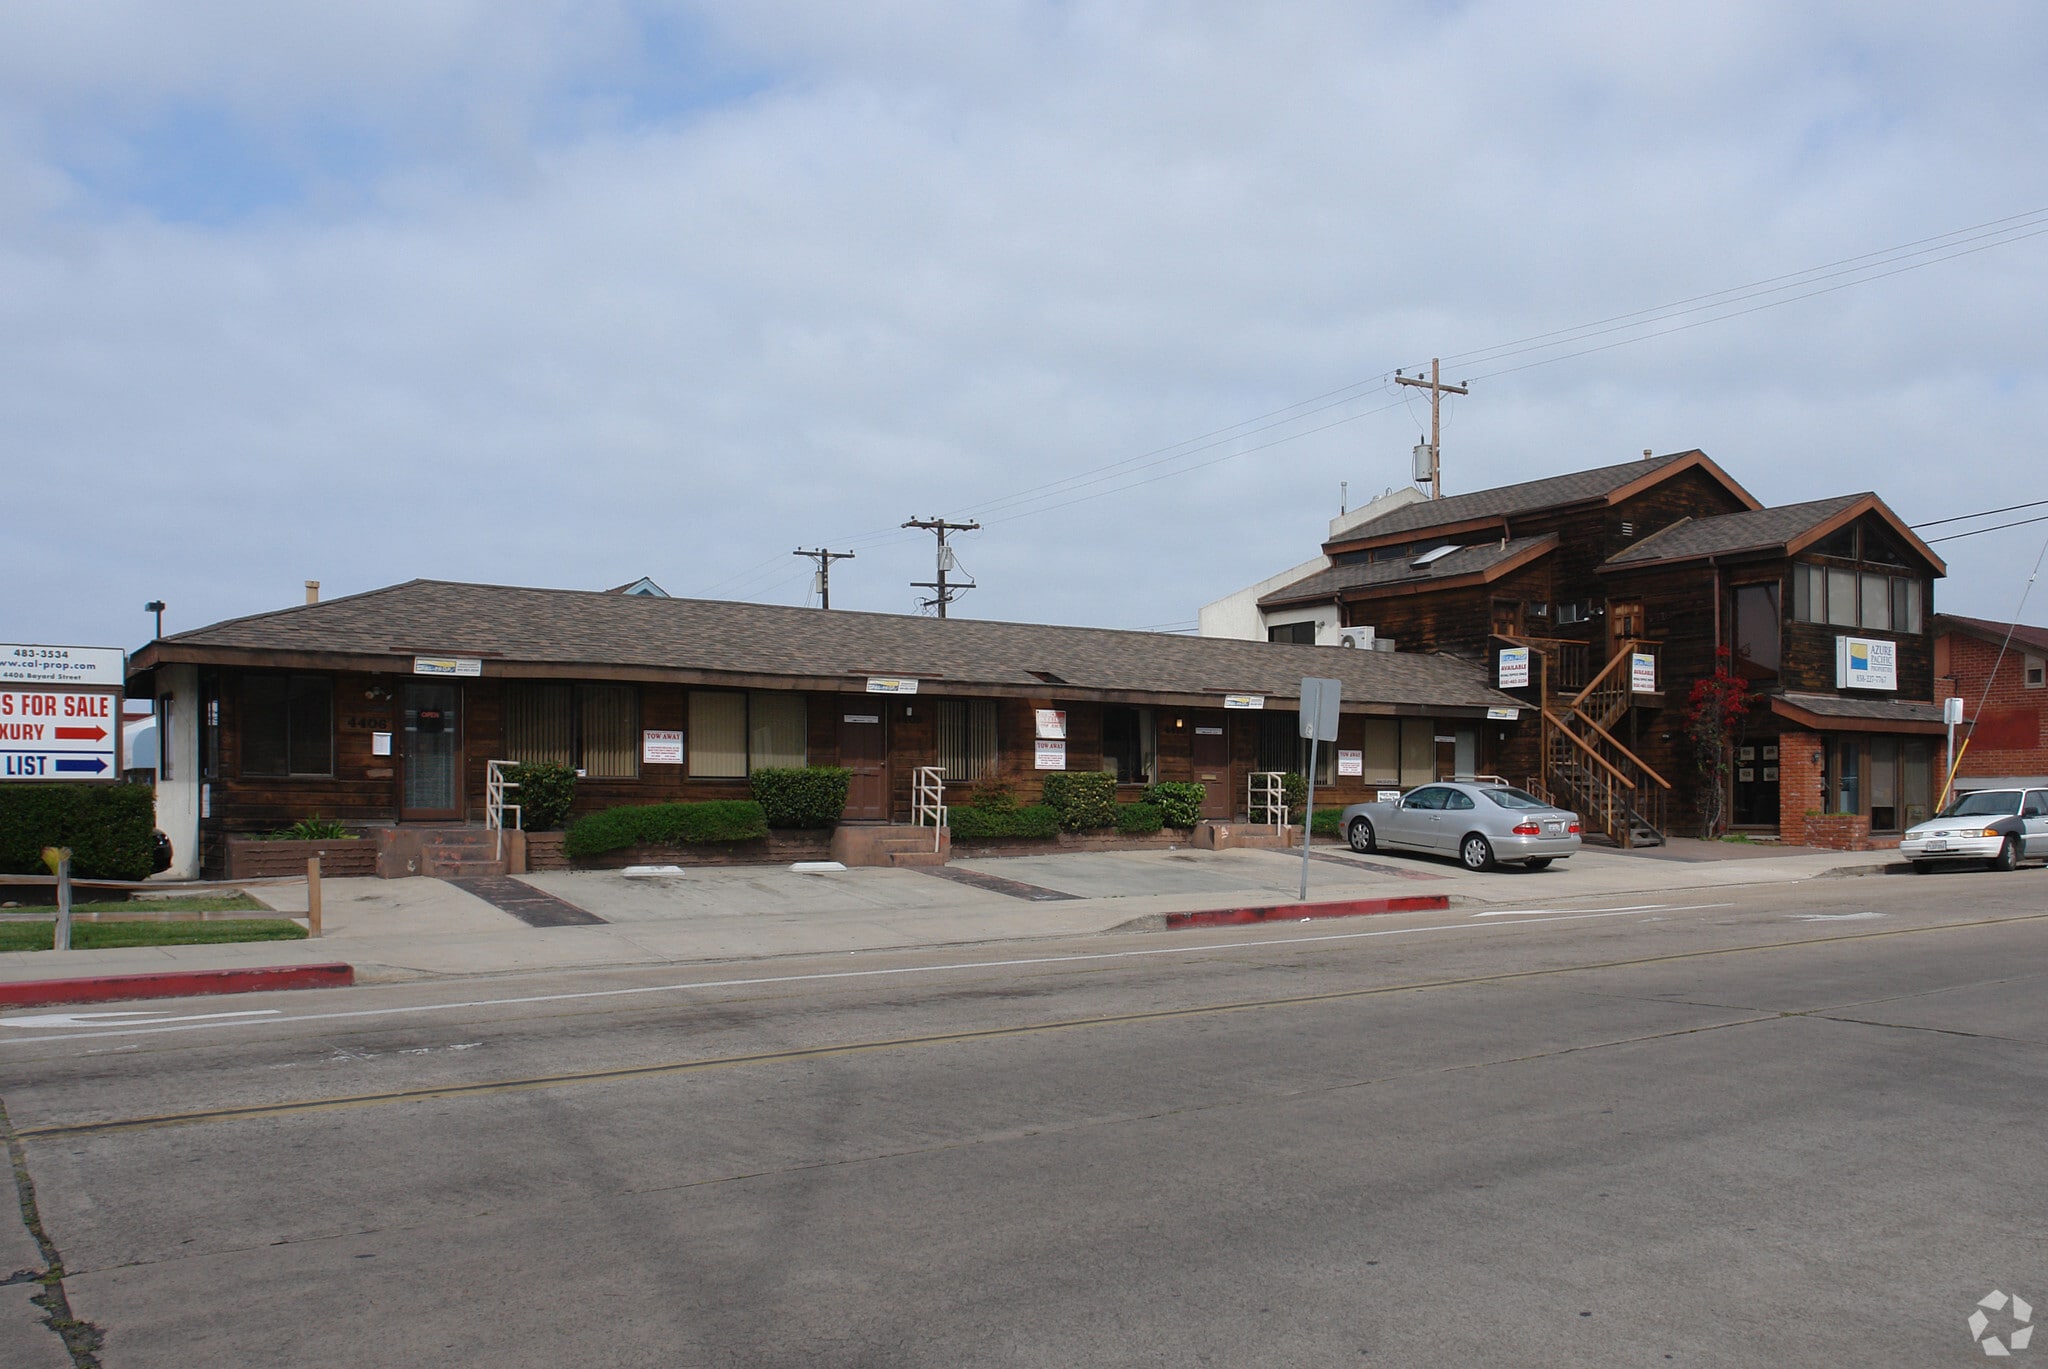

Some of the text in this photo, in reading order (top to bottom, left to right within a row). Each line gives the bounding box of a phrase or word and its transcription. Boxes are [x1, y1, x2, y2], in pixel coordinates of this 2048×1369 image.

[14, 649, 69, 659] 483-3534
[1871, 645, 1892, 656] AZURE
[1871, 655, 1892, 665] PACIFIC
[2, 694, 109, 718] S FOR SALE
[6, 755, 47, 776] LIST
